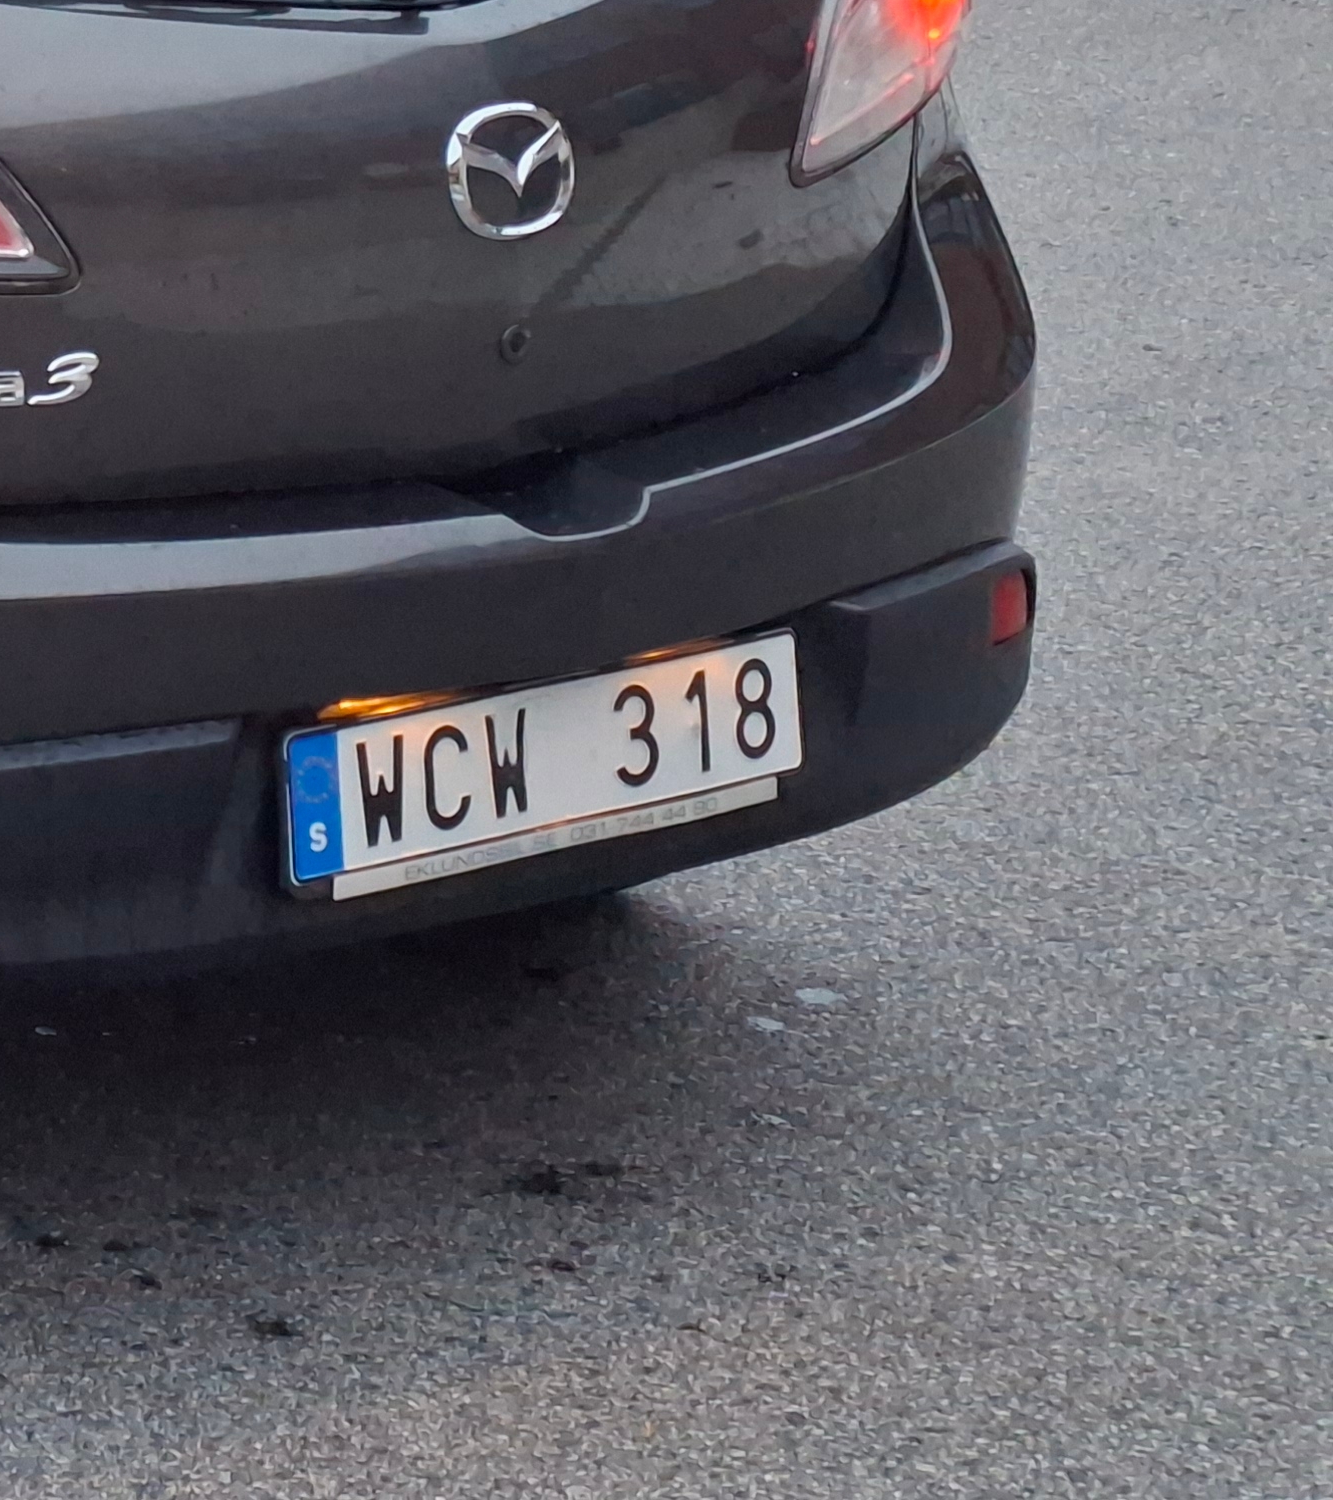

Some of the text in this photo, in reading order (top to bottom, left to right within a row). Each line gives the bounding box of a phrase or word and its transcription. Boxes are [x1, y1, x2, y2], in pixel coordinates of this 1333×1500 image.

[355, 657, 777, 848] WCW 318
[308, 822, 329, 853] S
